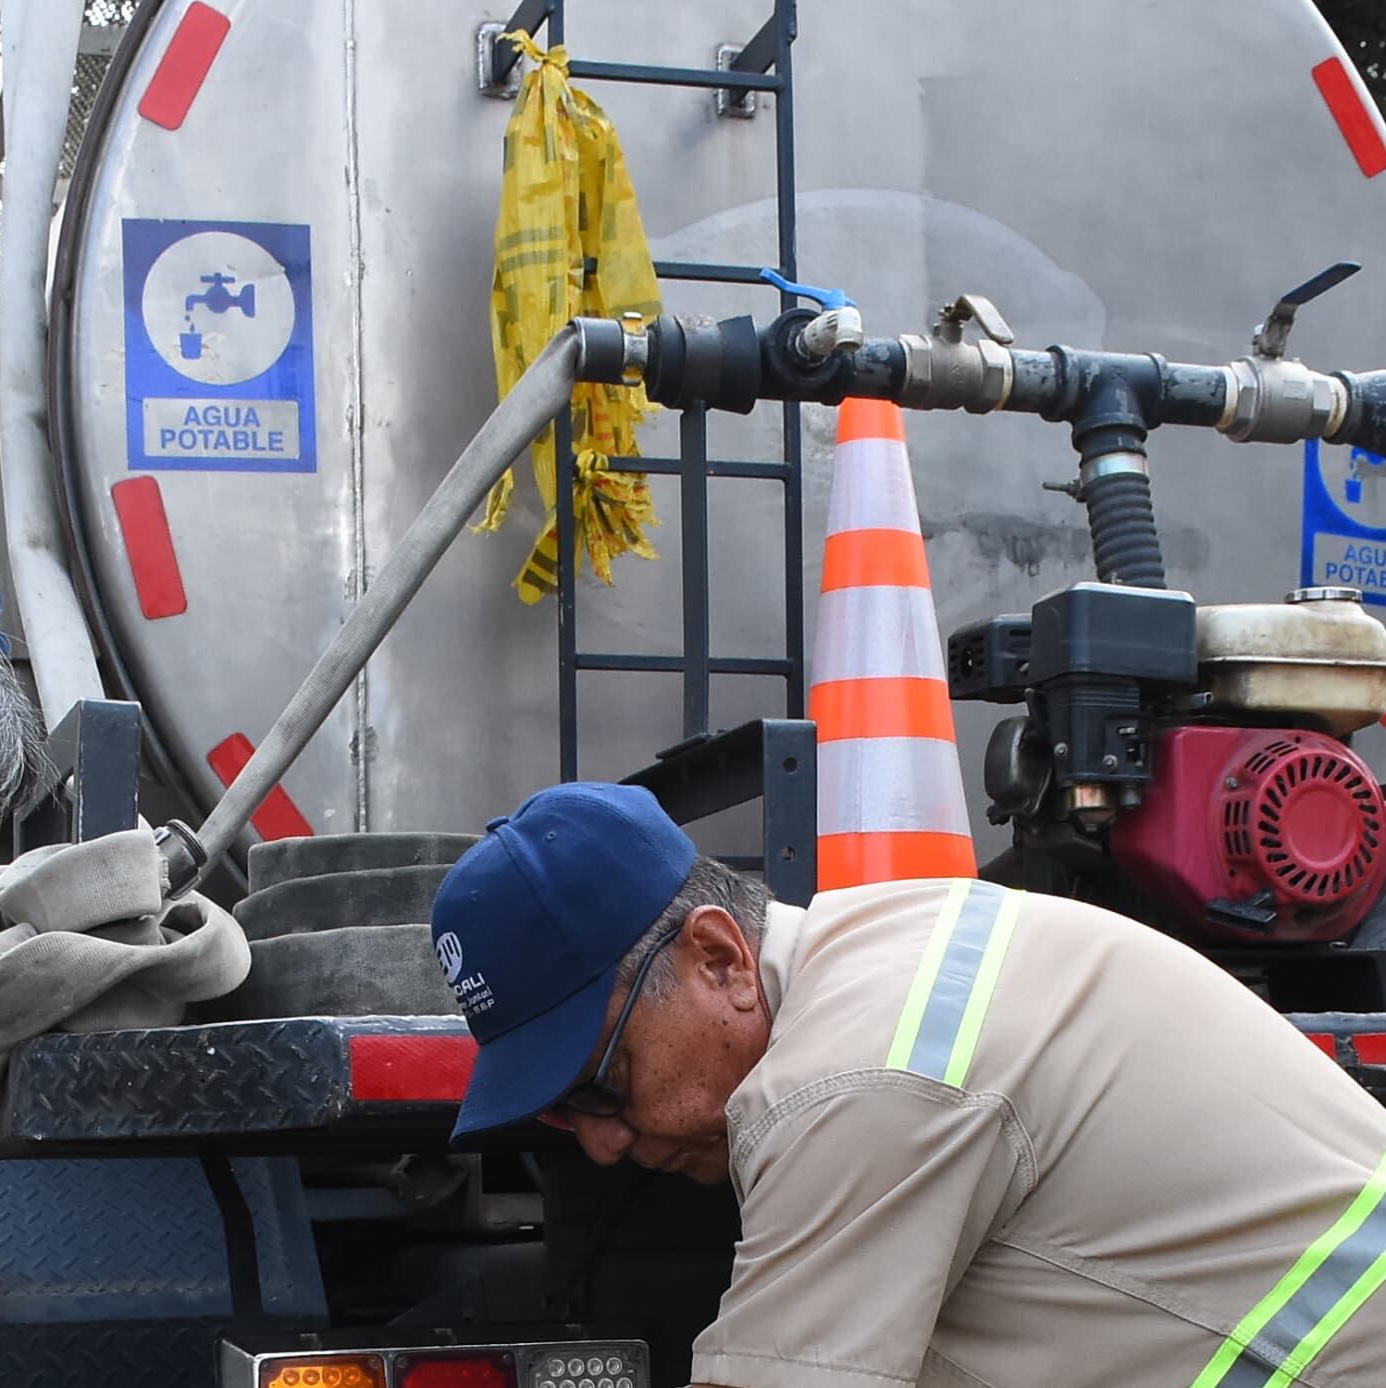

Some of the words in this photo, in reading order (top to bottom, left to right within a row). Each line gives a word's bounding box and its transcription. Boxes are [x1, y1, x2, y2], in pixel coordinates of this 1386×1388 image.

[183, 405, 261, 428] AGUA
[160, 428, 284, 452] POTABLE
[453, 971, 486, 996] CALI
